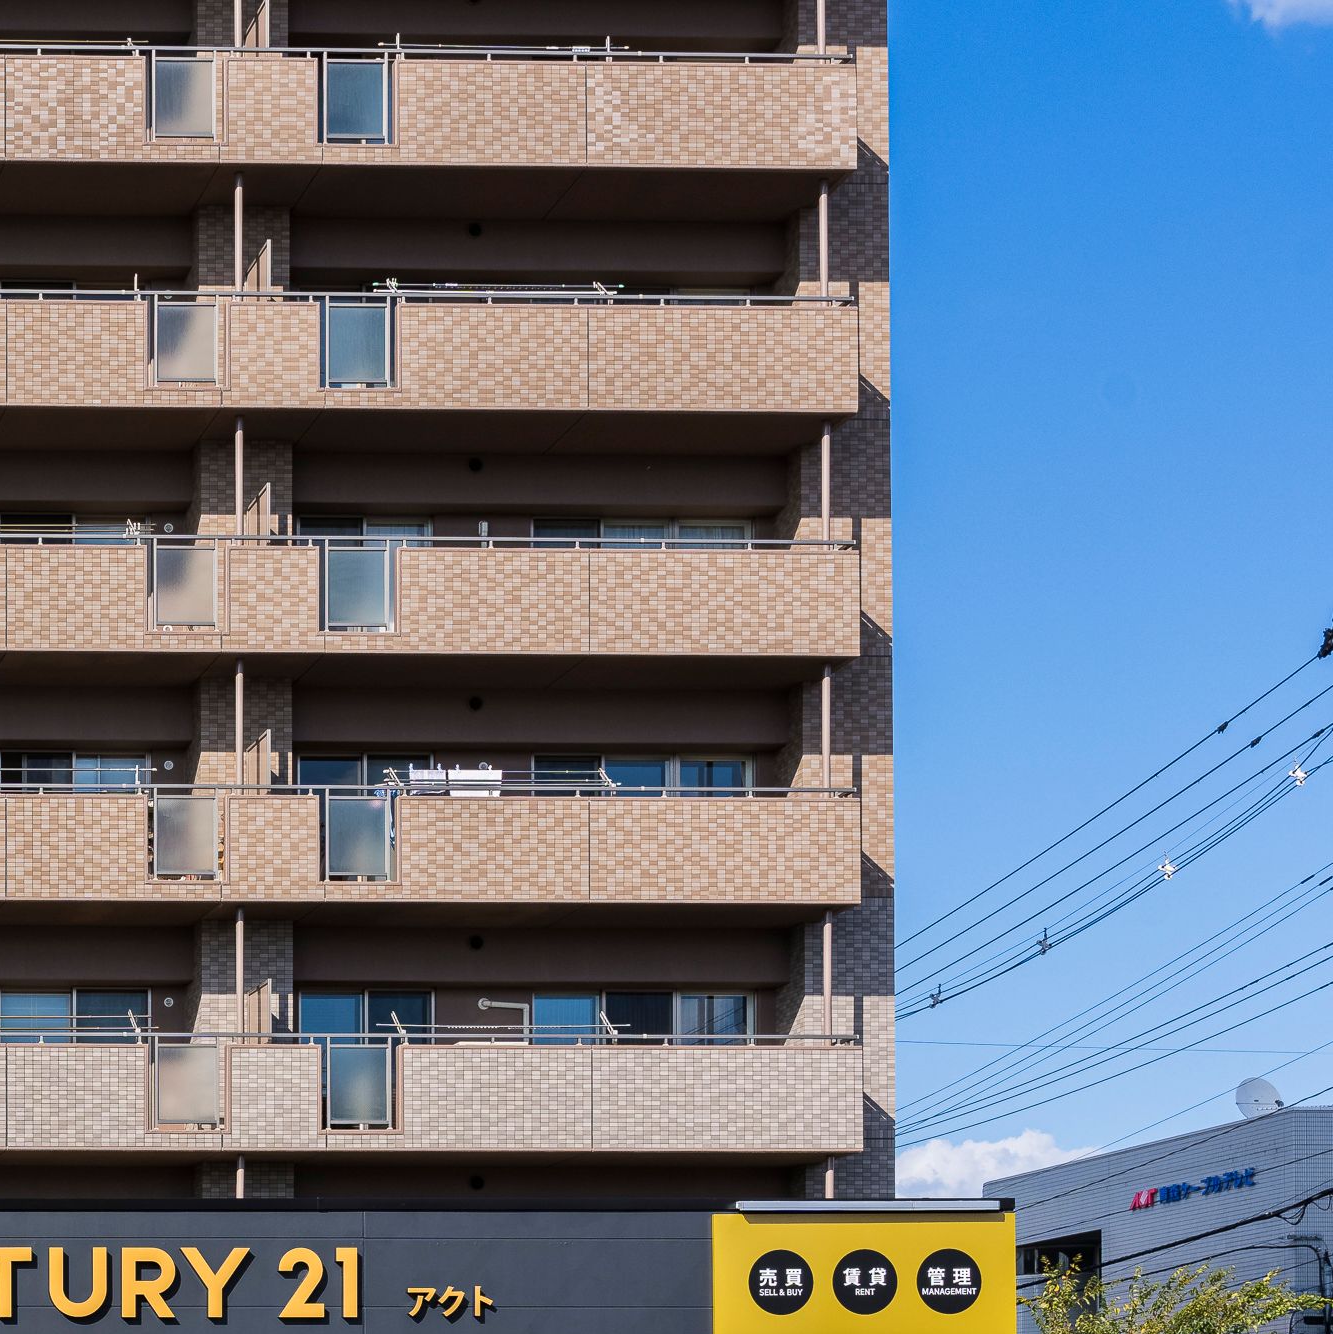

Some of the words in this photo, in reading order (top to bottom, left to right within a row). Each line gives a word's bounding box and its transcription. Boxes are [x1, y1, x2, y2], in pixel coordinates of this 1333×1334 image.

[278, 1247, 358, 1318] 21
[759, 1268, 803, 1287] 売買
[843, 1267, 887, 1287] 賃貸
[927, 1267, 971, 1287] 管理
[407, 1285, 494, 1317] アクト
[759, 1288, 778, 1297] SELL
[779, 1288, 786, 1297] &
[787, 1288, 804, 1297] BUY
[855, 1288, 875, 1296] RENT
[922, 1288, 977, 1296] MANAGEMENT
